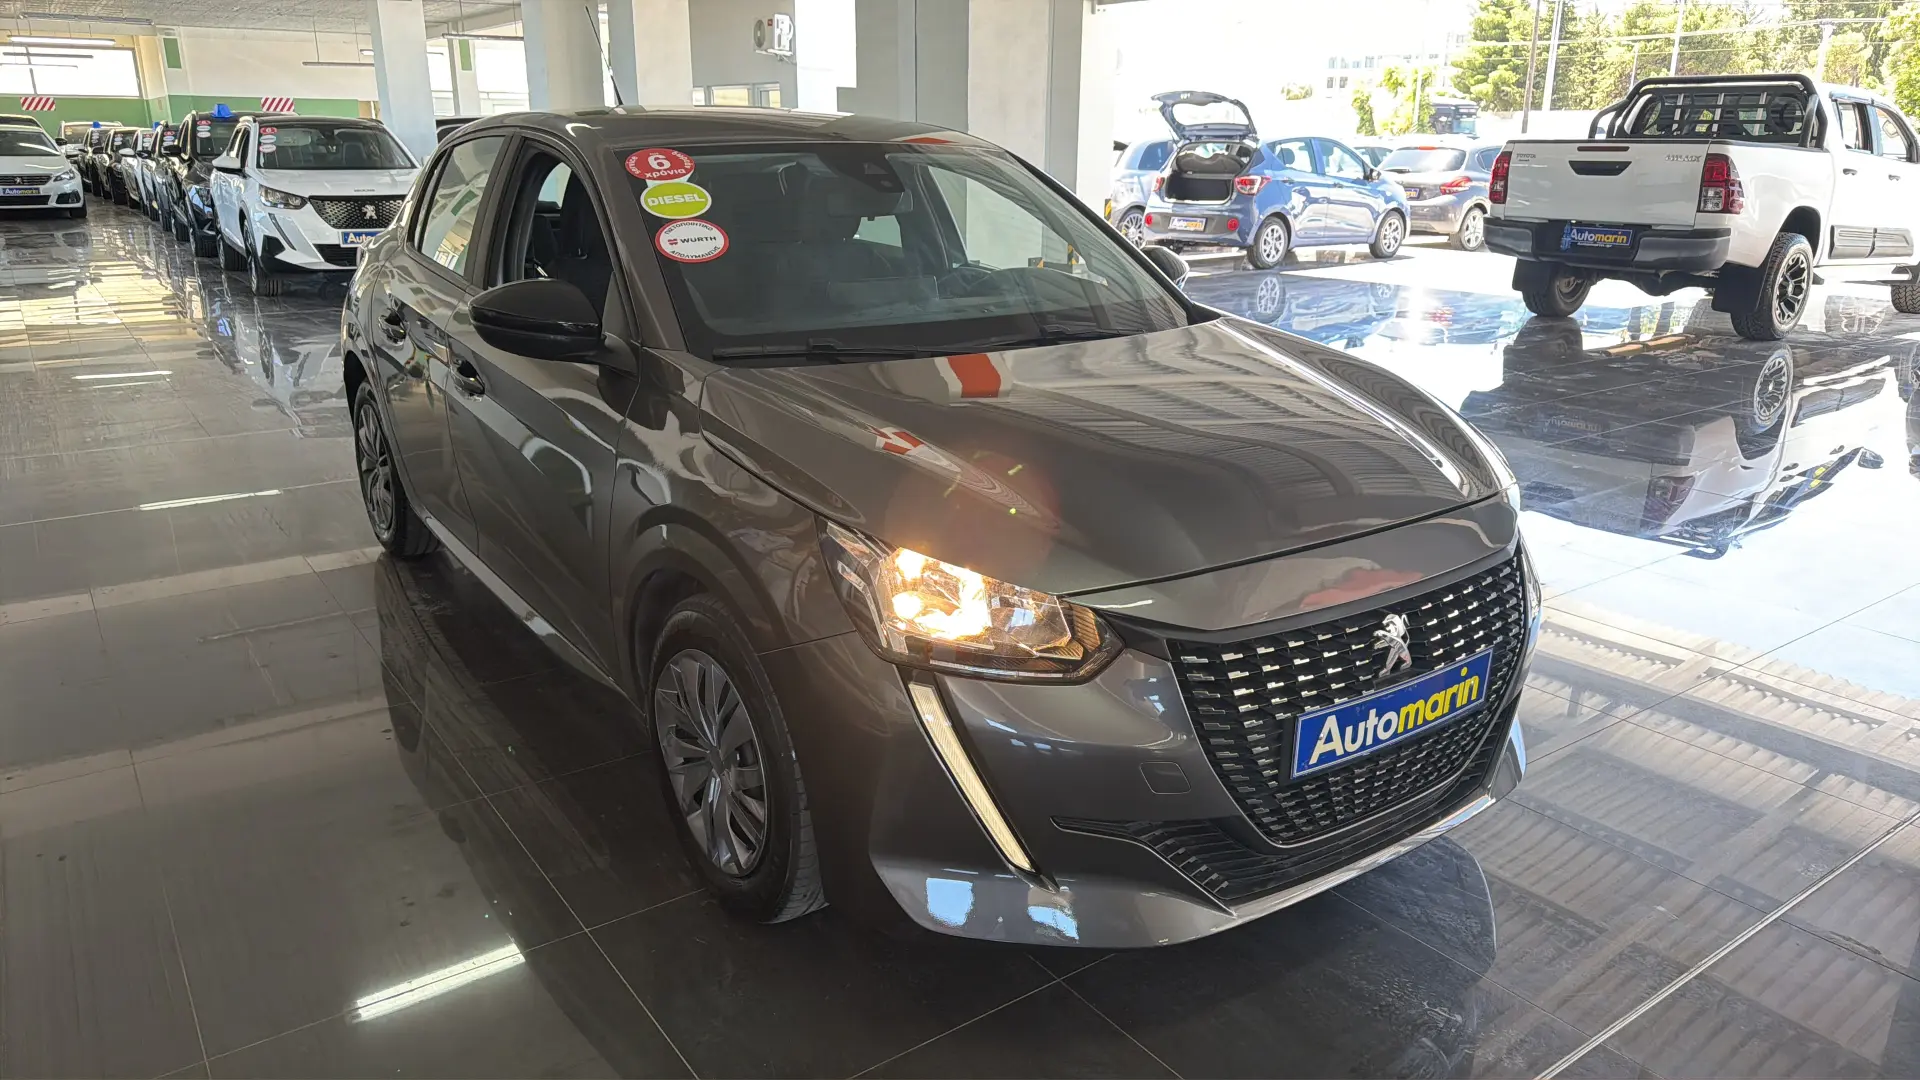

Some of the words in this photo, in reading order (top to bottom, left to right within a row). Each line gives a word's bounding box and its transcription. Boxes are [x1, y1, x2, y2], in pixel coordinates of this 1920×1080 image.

[647, 154, 671, 170] 6
[644, 168, 686, 179] χρόνια
[647, 193, 705, 207] DIESEL
[1570, 228, 1627, 244] Automarin
[1308, 666, 1480, 765] Automarin
